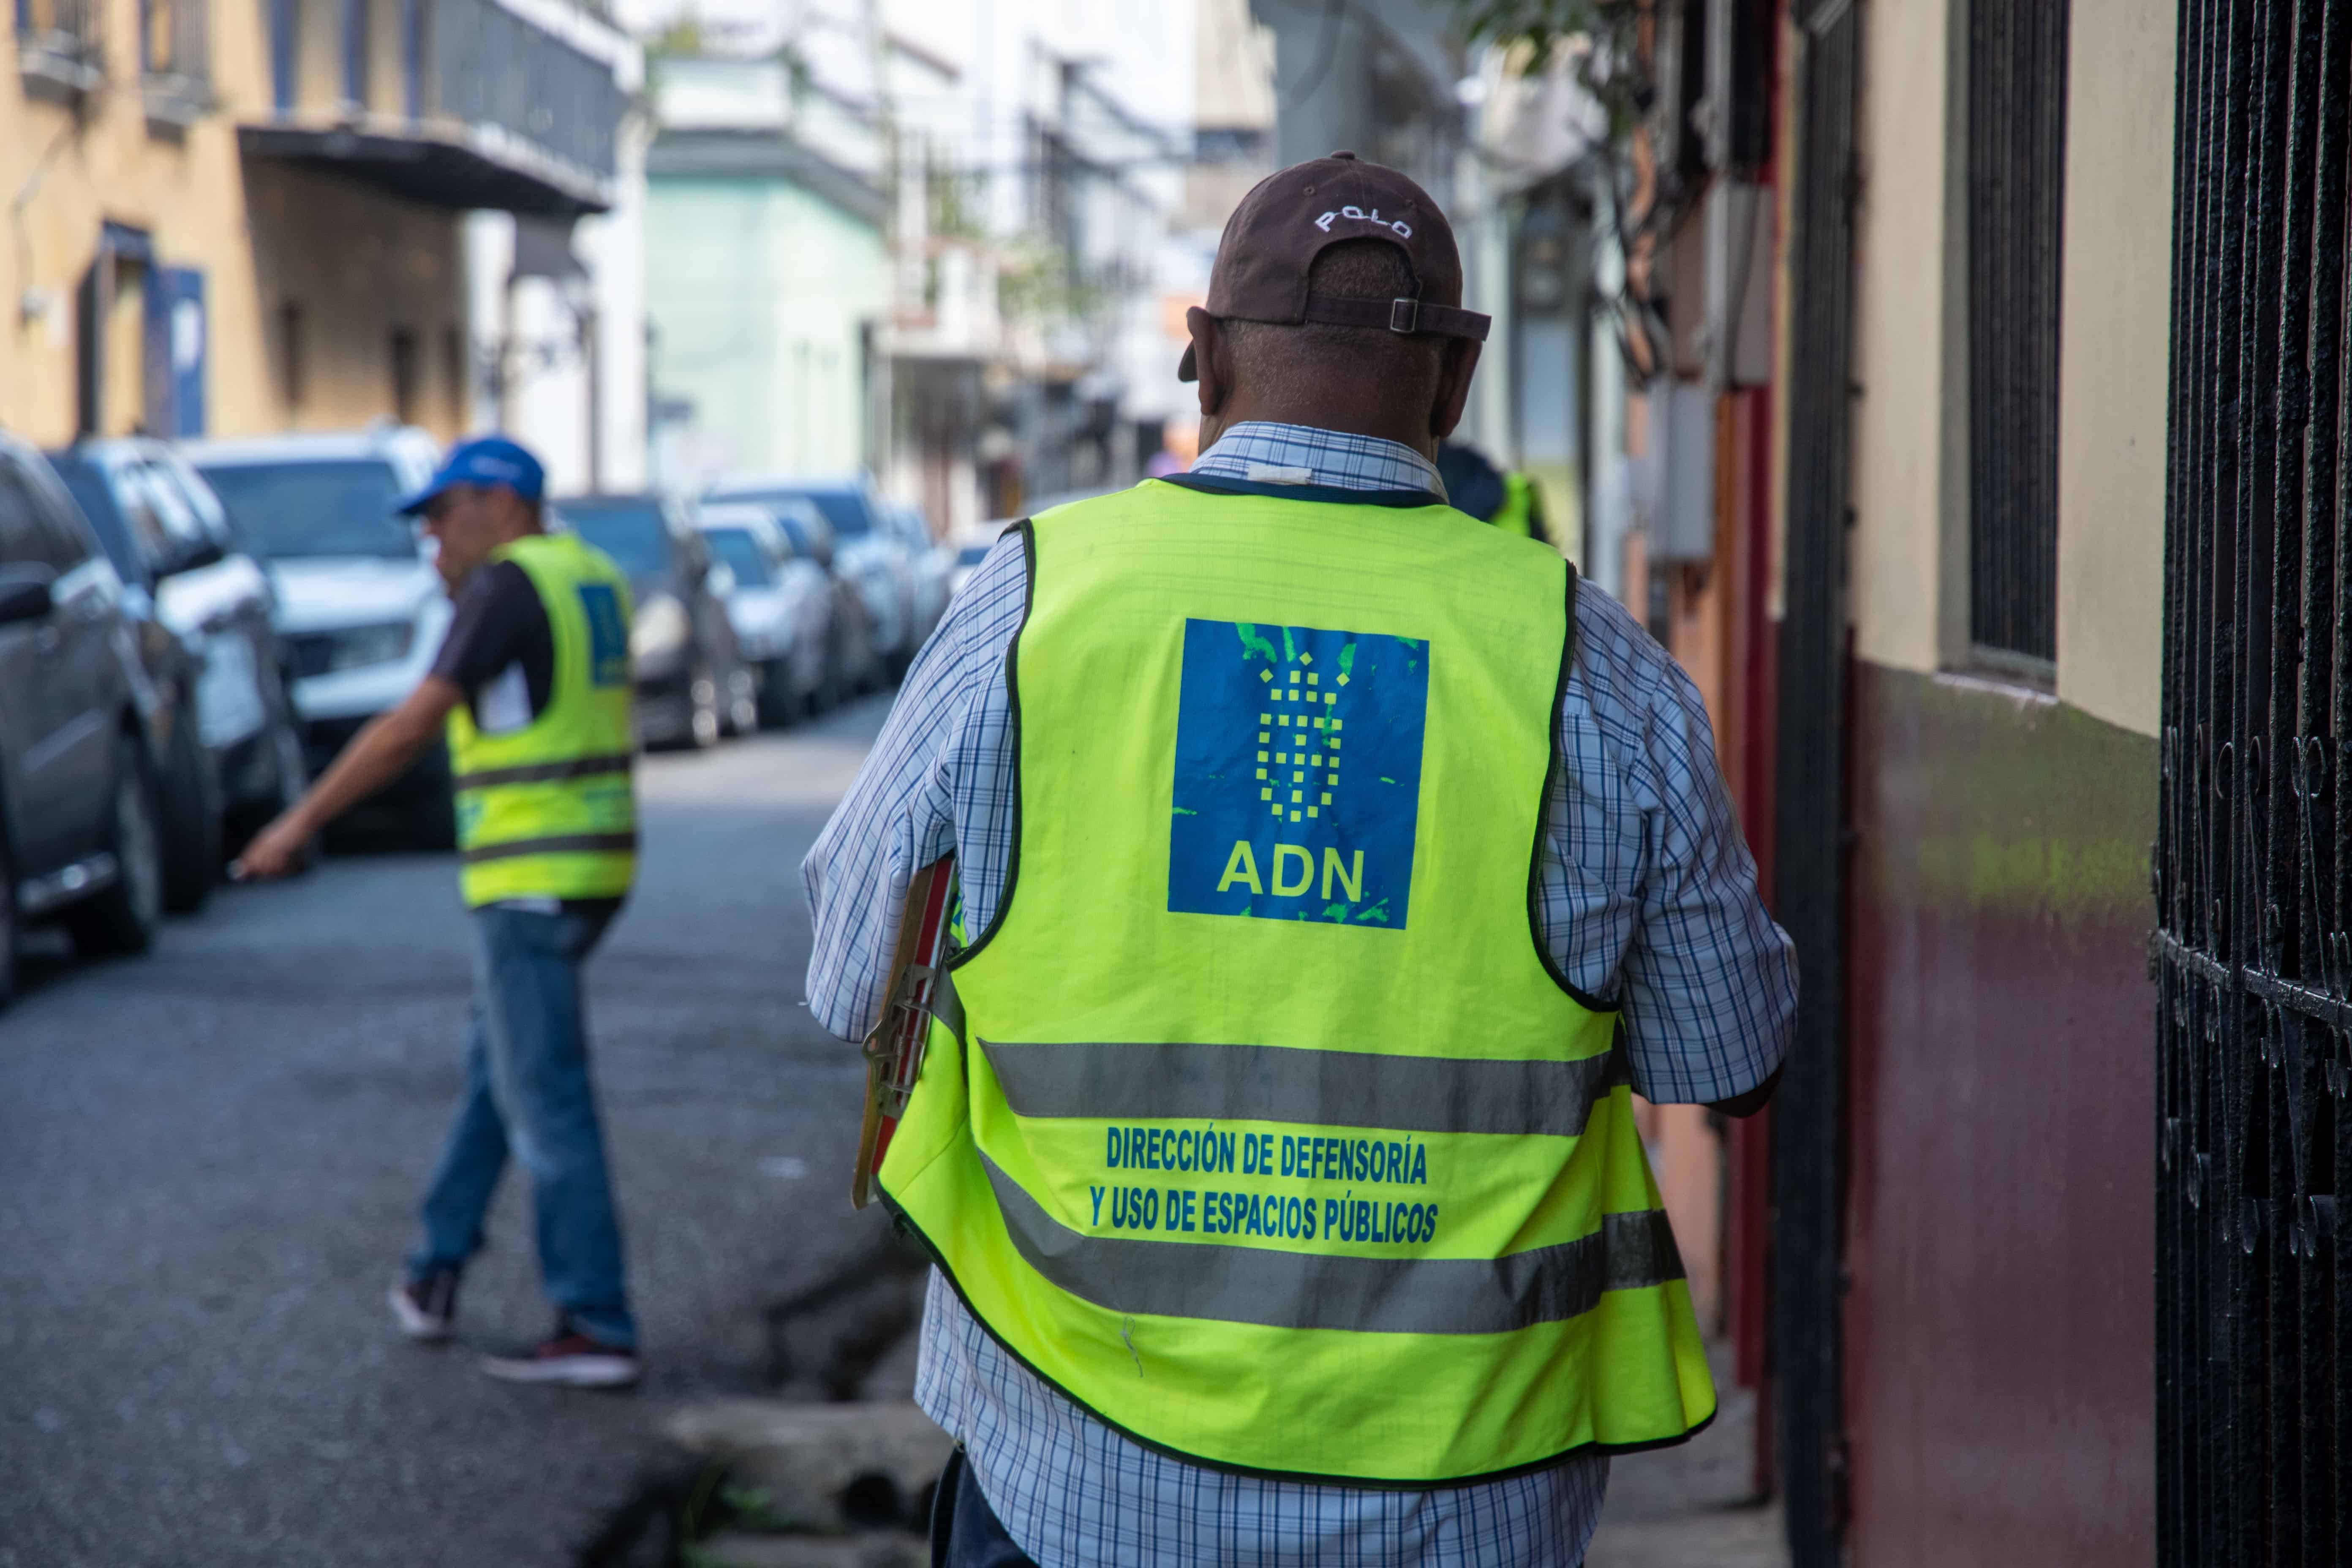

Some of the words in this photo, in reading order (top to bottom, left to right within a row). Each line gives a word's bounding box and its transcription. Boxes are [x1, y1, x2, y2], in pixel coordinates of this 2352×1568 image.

[1315, 205, 1413, 240] POLO
[1216, 840, 1364, 903] ADN
[1106, 1122, 1236, 1173] DIRECCIÓN
[1243, 1133, 1274, 1175] DE
[1281, 1135, 1427, 1184] DEFENSORÍA
[1089, 1186, 1106, 1226] Y
[1112, 1187, 1159, 1230] USO
[1165, 1190, 1196, 1232] DE
[1203, 1192, 1317, 1240] ESPACIOS
[1324, 1190, 1438, 1244] PÚBLICOS
